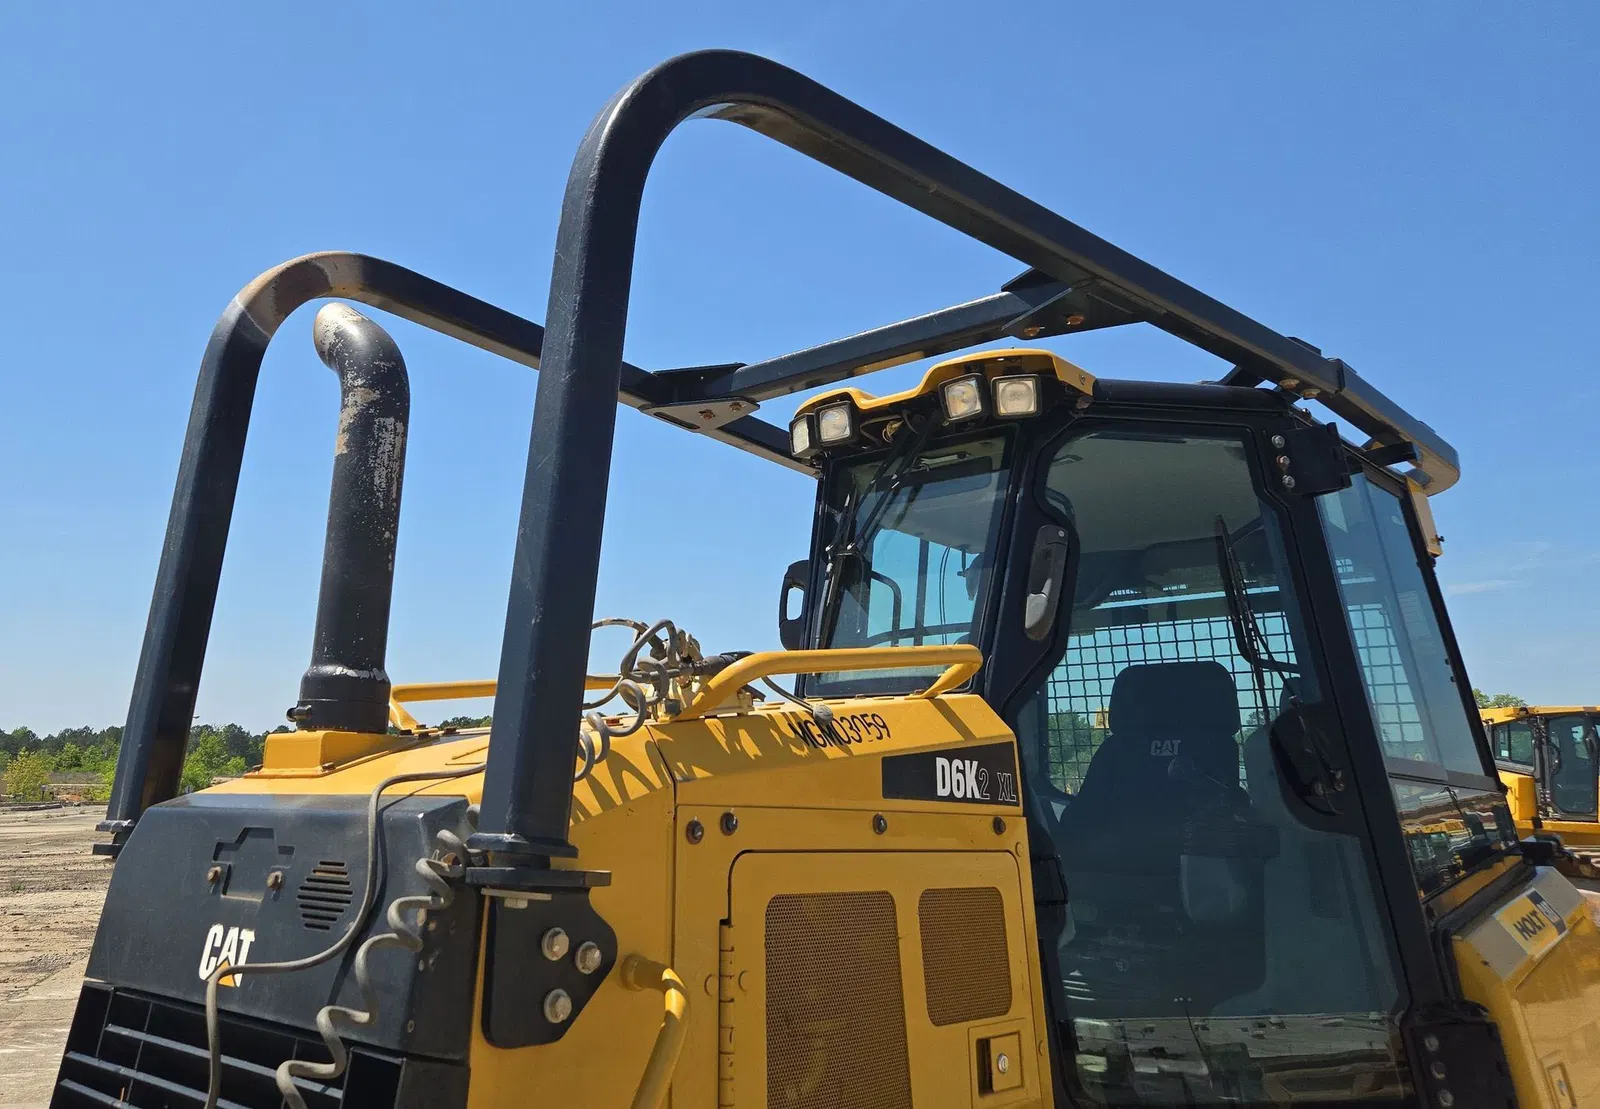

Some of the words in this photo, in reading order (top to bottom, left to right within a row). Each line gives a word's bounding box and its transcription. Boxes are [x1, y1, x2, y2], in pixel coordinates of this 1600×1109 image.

[1150, 739, 1181, 756] CAT
[936, 757, 990, 799] D6K2
[997, 772, 1017, 802] XL
[1512, 910, 1545, 941] HOLT
[199, 923, 255, 987] CAT
